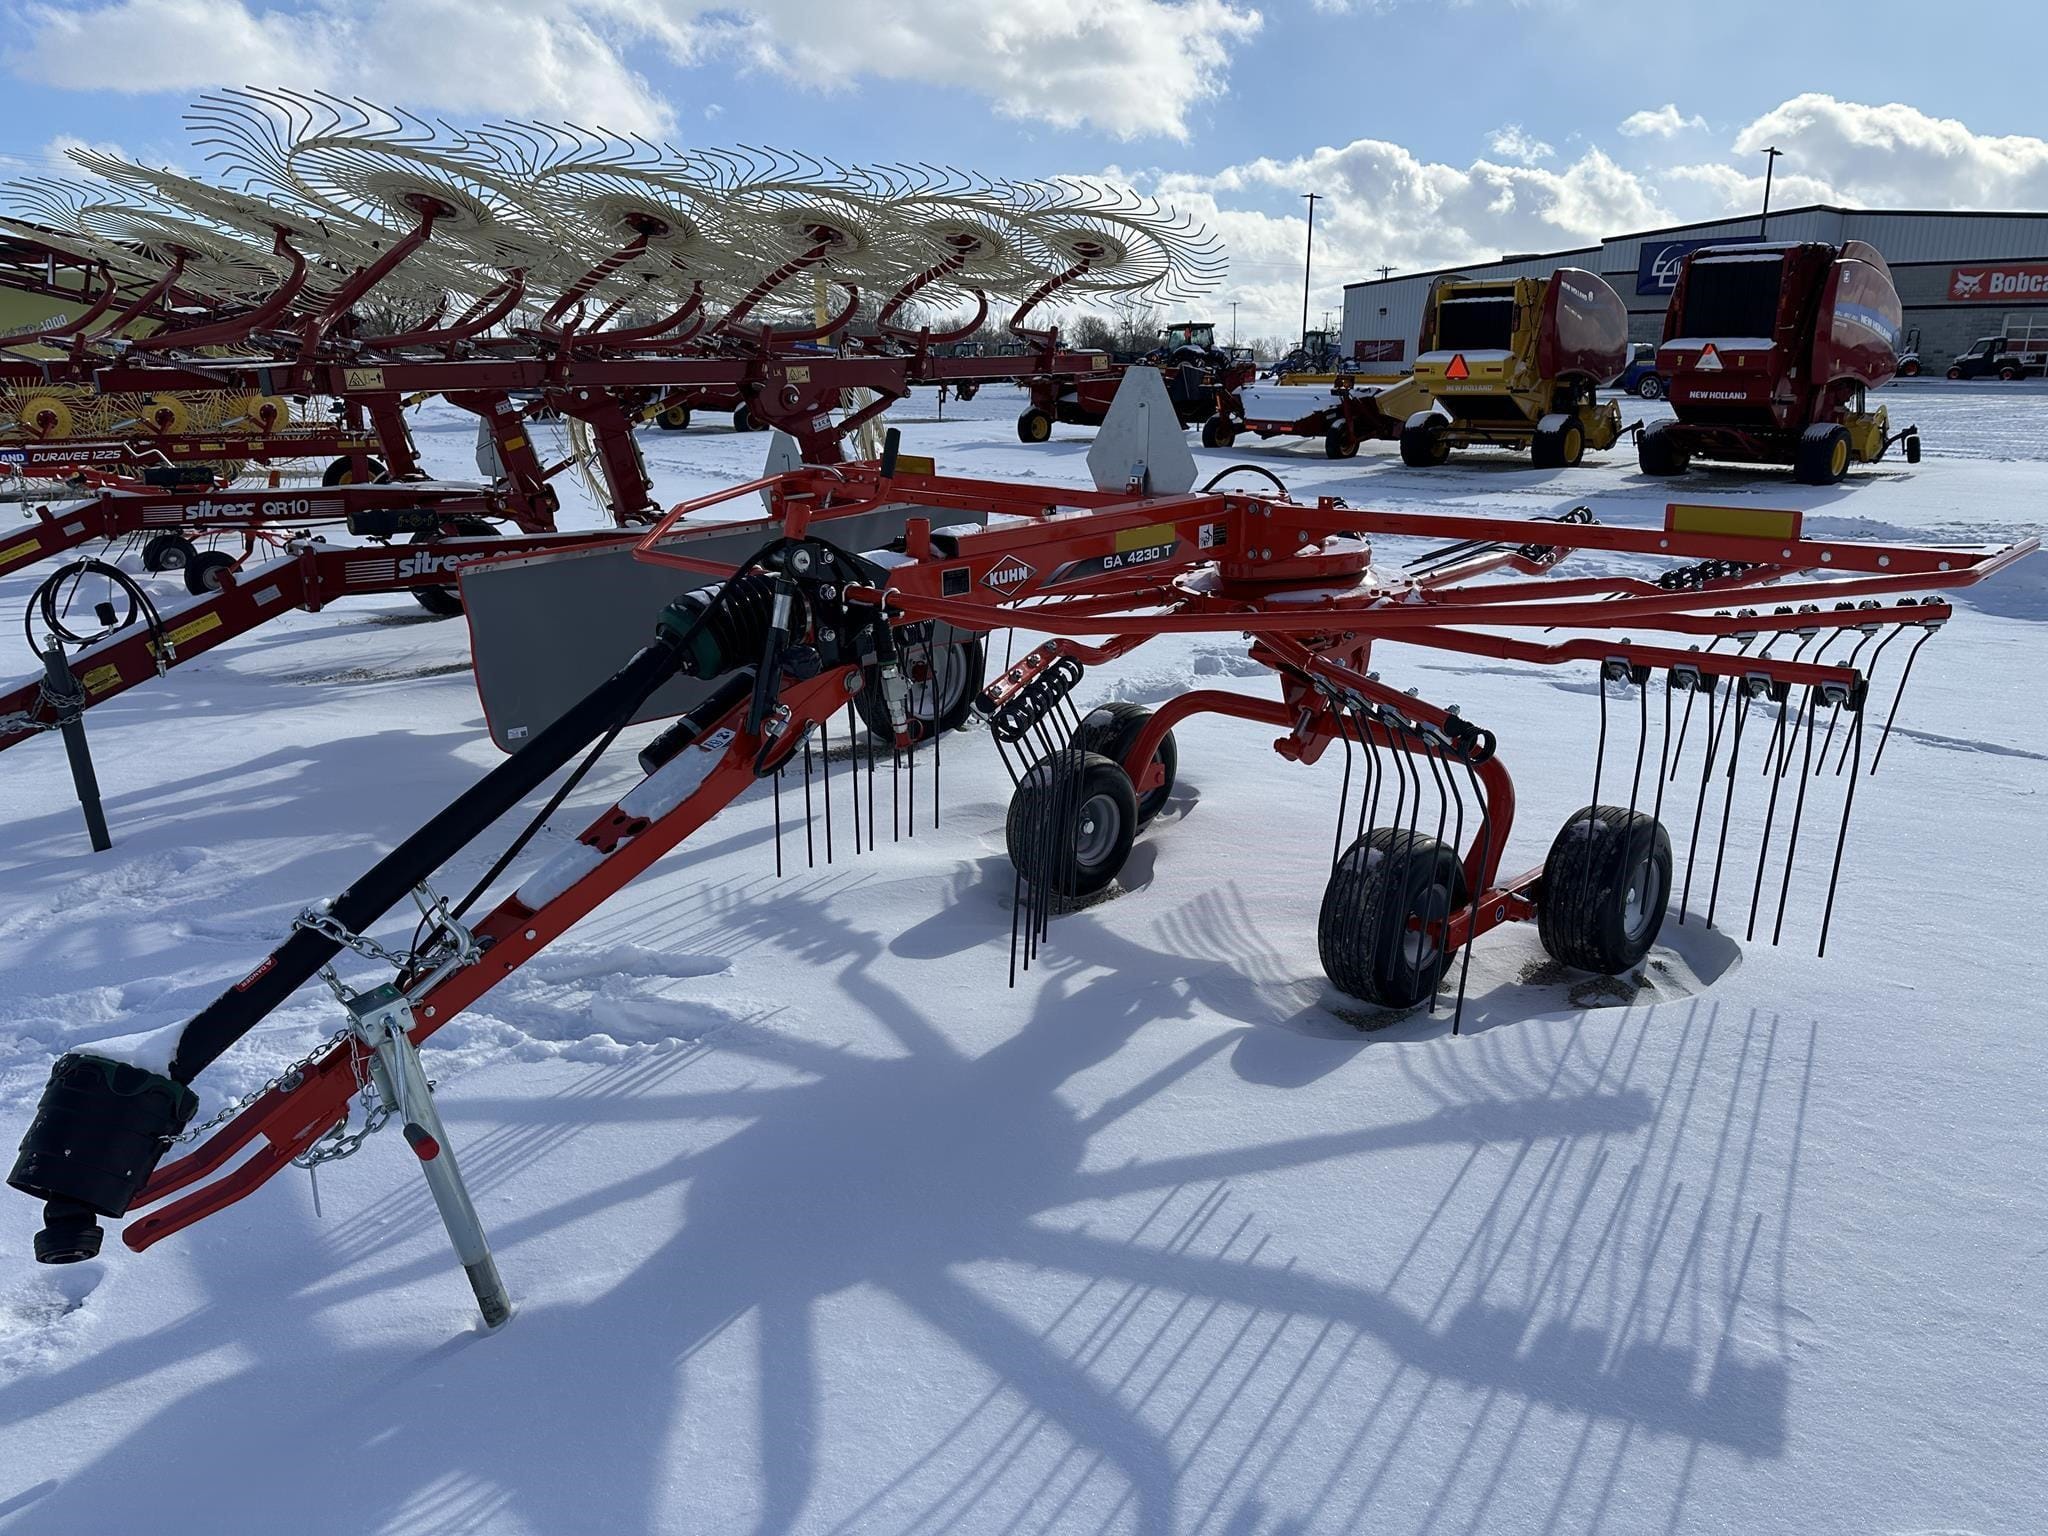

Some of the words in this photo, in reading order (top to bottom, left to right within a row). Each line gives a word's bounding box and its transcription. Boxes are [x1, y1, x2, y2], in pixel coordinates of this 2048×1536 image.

[1709, 391, 1747, 400] HOLLAND
[32, 451, 89, 462] DURAVEE
[92, 450, 122, 460] 1225
[185, 500, 255, 520] sitrex
[262, 499, 309, 515] QR10
[1103, 556, 1122, 569] GA
[1127, 547, 1160, 564] 4230
[1163, 544, 1172, 556] T
[989, 566, 1028, 586] KUHN
[240, 964, 268, 987] DANGER
